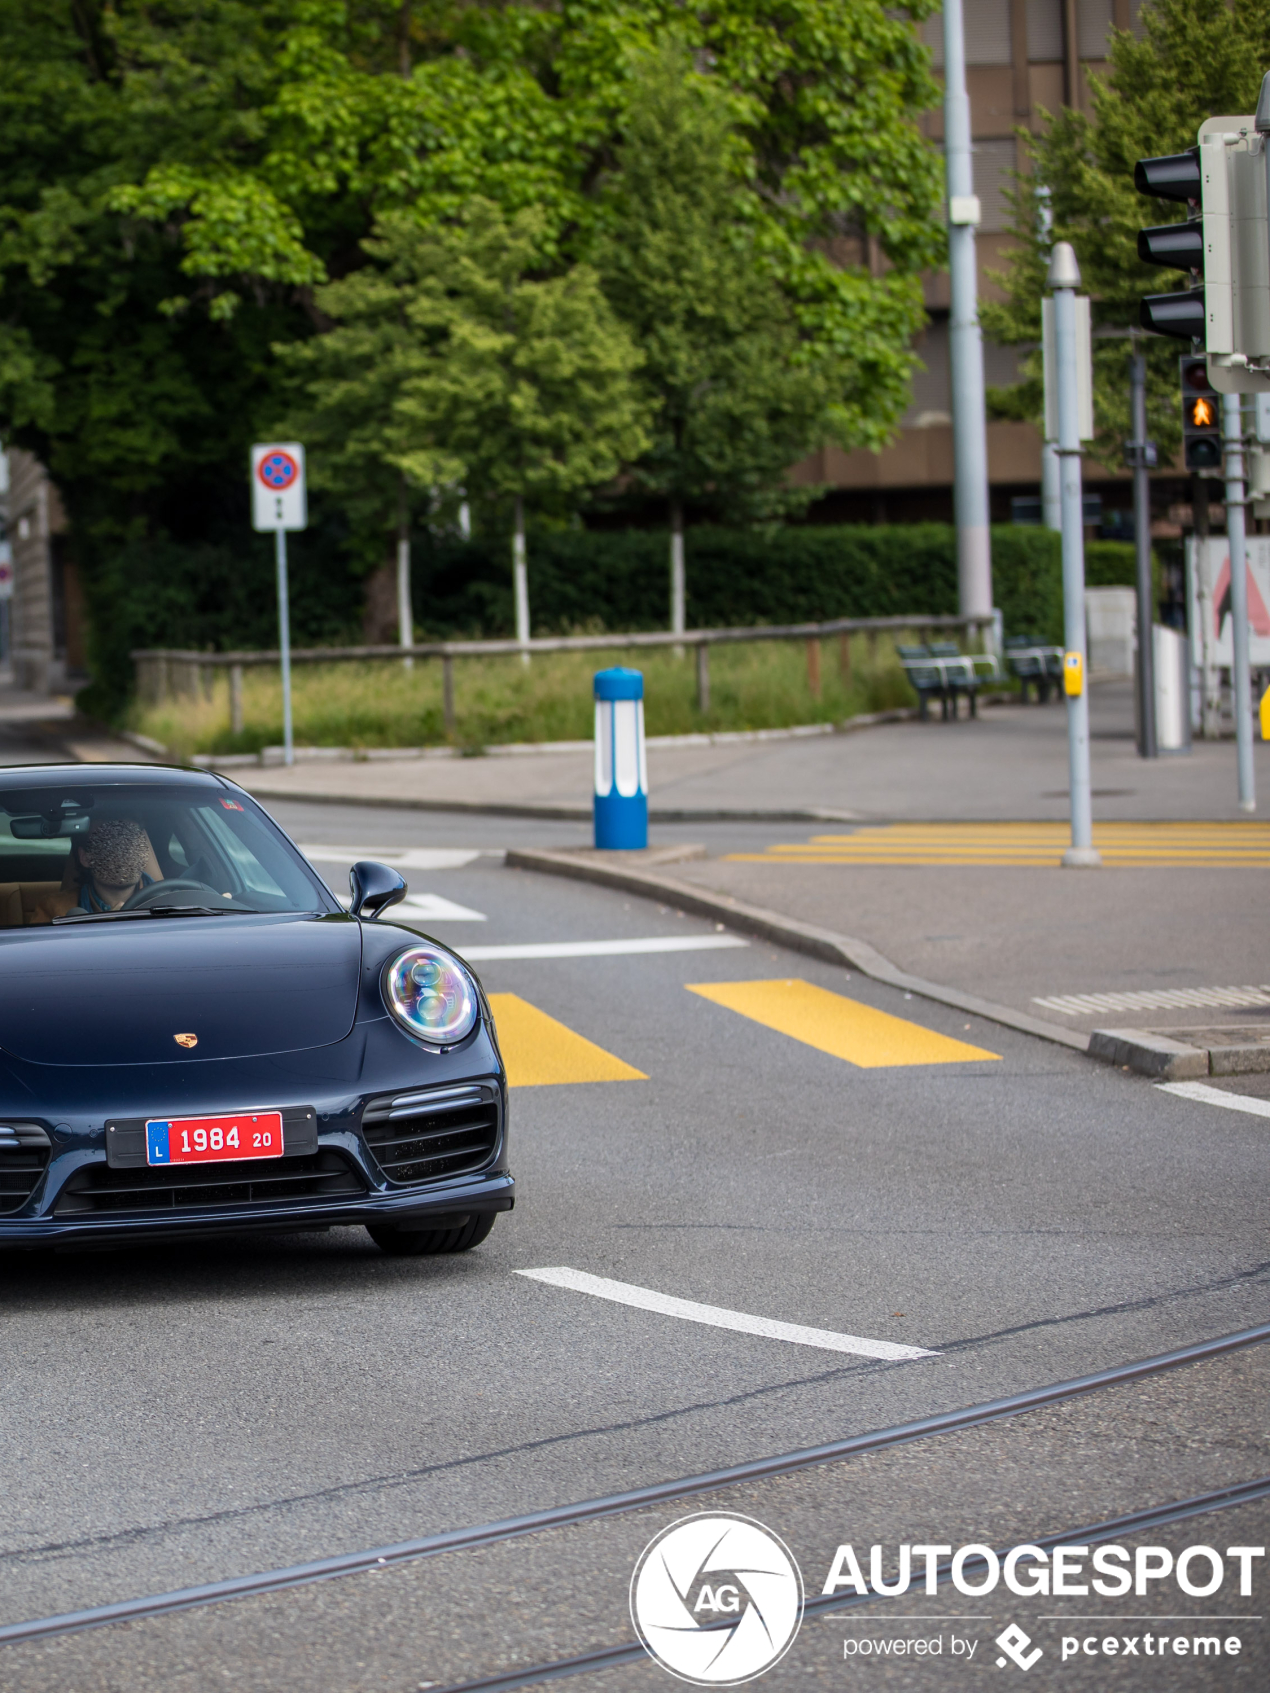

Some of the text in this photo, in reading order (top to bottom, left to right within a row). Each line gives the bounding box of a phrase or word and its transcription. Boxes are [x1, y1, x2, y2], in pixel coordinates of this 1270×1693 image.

[181, 1126, 272, 1152] 1984 20
[155, 1146, 163, 1158] L
